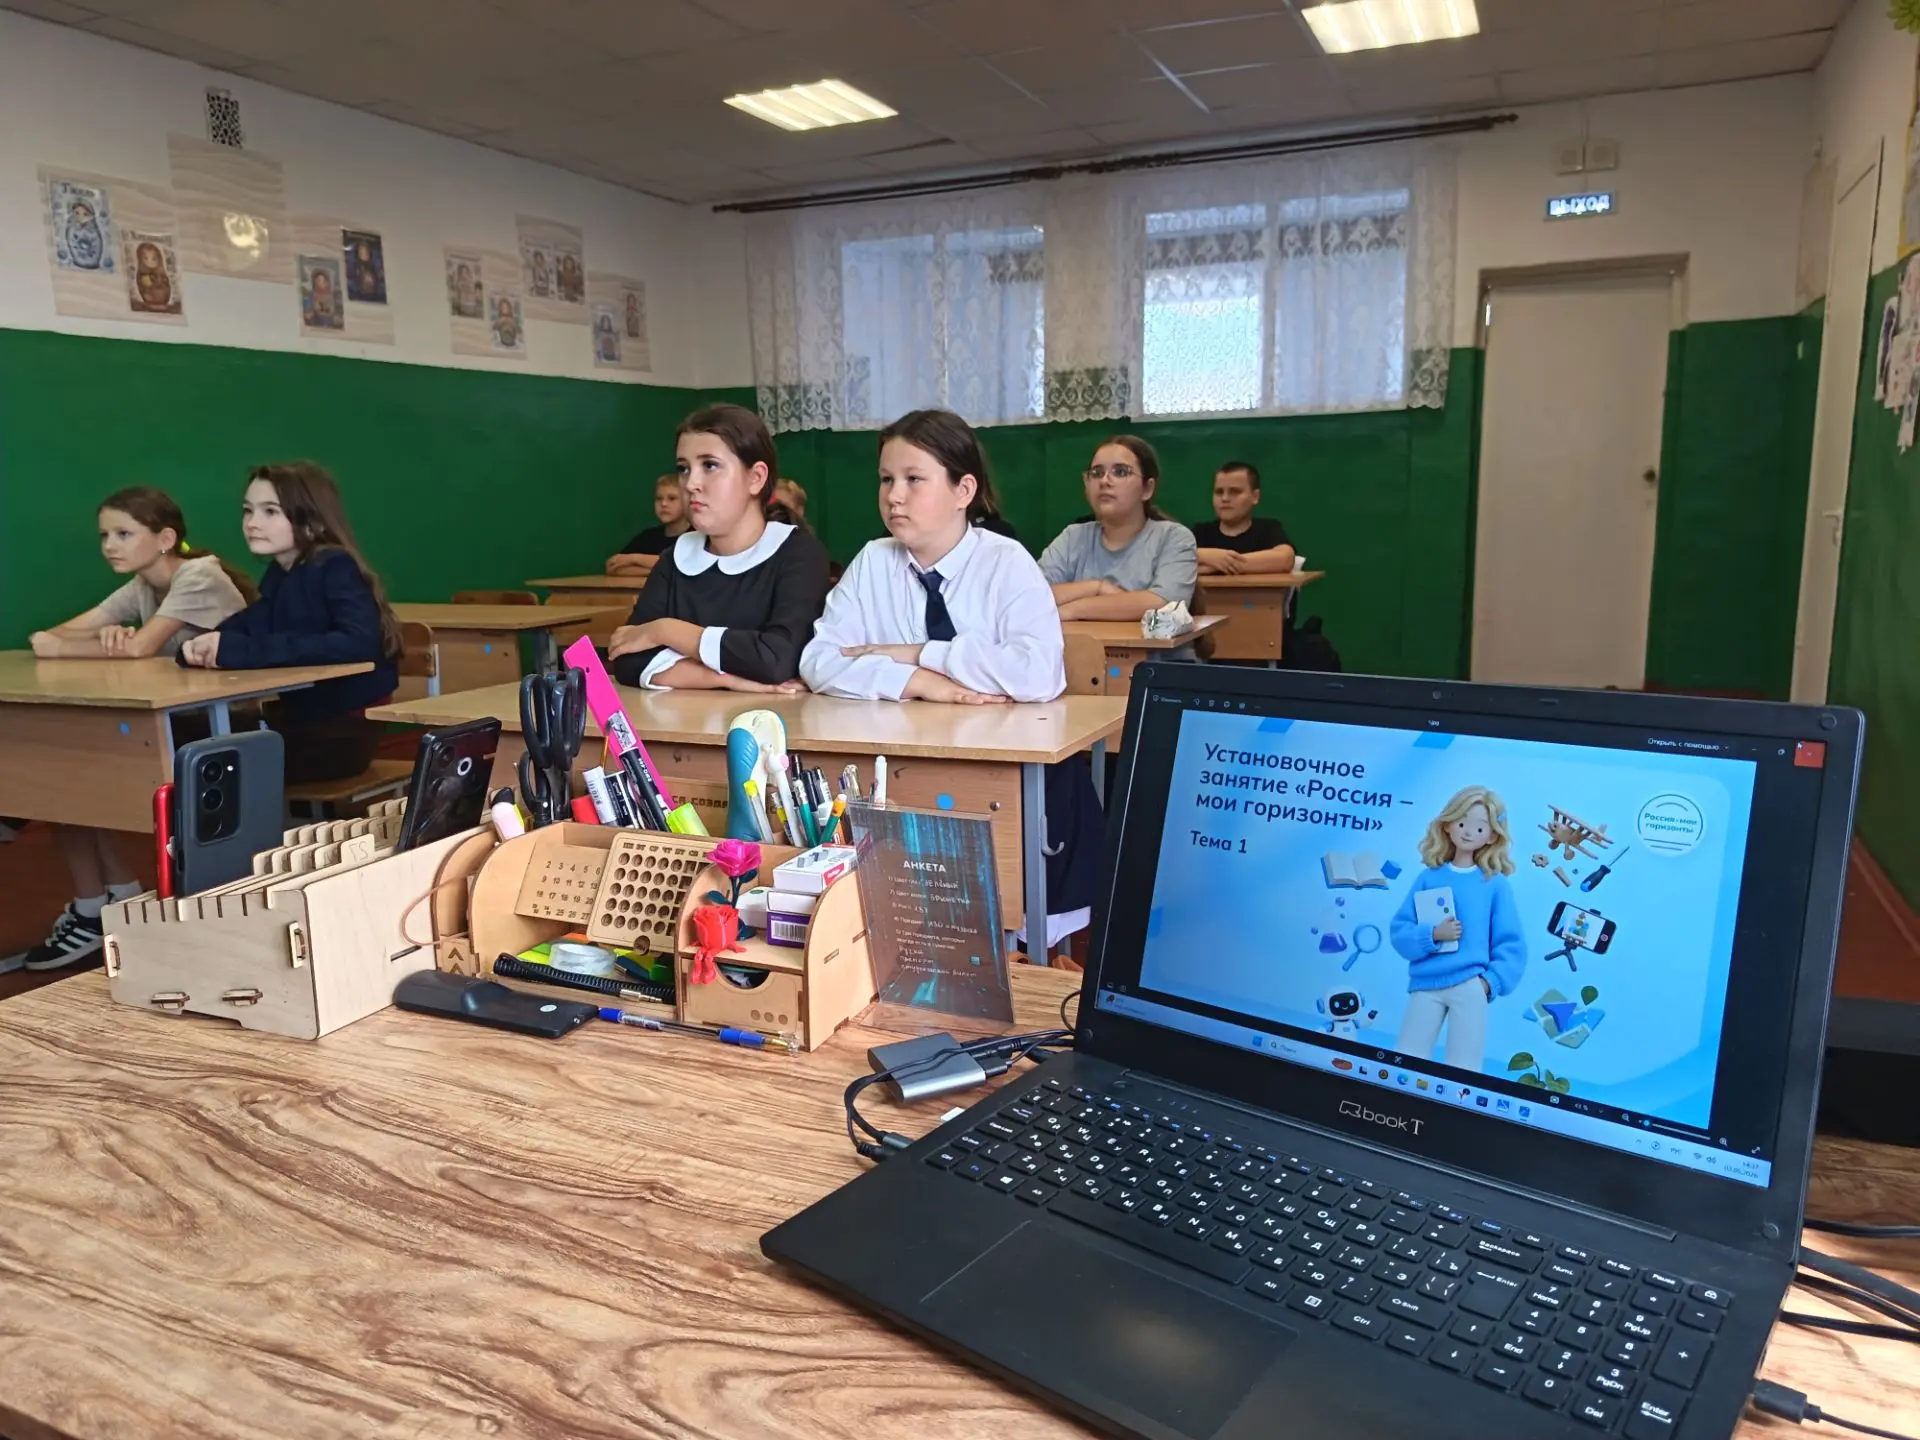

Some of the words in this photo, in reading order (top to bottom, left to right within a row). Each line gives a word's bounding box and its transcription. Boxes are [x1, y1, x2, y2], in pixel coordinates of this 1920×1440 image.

[1549, 194, 1610, 216] ВЫХОД
[1647, 737, 1677, 748] Открыть
[1684, 742, 1720, 751] помощью
[1205, 742, 1365, 779] Установочное
[1199, 769, 1289, 795] занятие
[1295, 779, 1393, 808] «Россия
[1195, 793, 1237, 812] мои
[1243, 800, 1383, 832] горизонты»
[1645, 822, 1694, 834] горизонты
[1190, 830, 1233, 851] Тема
[1238, 838, 1248, 854] 1
[545, 860, 552, 869] 2
[558, 862, 564, 871] 3
[570, 864, 576, 872] 4
[583, 865, 589, 874] 5
[903, 860, 947, 873] АНКЕТА
[553, 877, 561, 885] 10
[566, 879, 573, 887] 11
[577, 880, 586, 889] 12
[548, 892, 557, 900] 17
[555, 908, 565, 917] 25
[1078, 1127, 1090, 1135] W
[1138, 1148, 1150, 1156] R
[1022, 1155, 1033, 1163] Z
[1053, 1167, 1065, 1175] X
[1120, 1165, 1132, 1173] F
[1208, 1172, 1218, 1180] Y
[1241, 1184, 1253, 1192] U
[1120, 1191, 1131, 1199] V
[1122, 1200, 1135, 1208] М
[1225, 1204, 1236, 1212] J
[1283, 1205, 1296, 1214] Ш
[1317, 1210, 1329, 1218] O
[1187, 1217, 1200, 1226] N
[1235, 1214, 1246, 1222] О
[1263, 1218, 1276, 1226] K
[1324, 1218, 1337, 1228] Щ
[1355, 1223, 1368, 1231] P
[1225, 1231, 1239, 1240] M
[1272, 1228, 1284, 1236] Л
[1303, 1232, 1311, 1240] L
[1233, 1242, 1243, 1250] Ь
[1310, 1242, 1324, 1250] Д
[1479, 1239, 1521, 1257] Backspace
[1407, 1248, 1419, 1257] Х
[1350, 1256, 1366, 1265] Ж
[1449, 1262, 1459, 1271] Ъ
[1310, 1271, 1325, 1281] Ю
[1396, 1272, 1408, 1281] Э
[1652, 1273, 1677, 1285] Pause
[1495, 1276, 1519, 1288] Enter
[1548, 1286, 1558, 1294] 7
[1532, 1291, 1560, 1306] Home
[1353, 1315, 1371, 1326] Ctrl
[1624, 1321, 1651, 1336] PgUp
[1503, 1342, 1524, 1355] End
[1561, 1351, 1572, 1360] 2
[1610, 1368, 1620, 1377] 3
[1544, 1379, 1555, 1388] 0
[1596, 1375, 1624, 1391] PgDn
[1641, 1401, 1671, 1417] Enter
